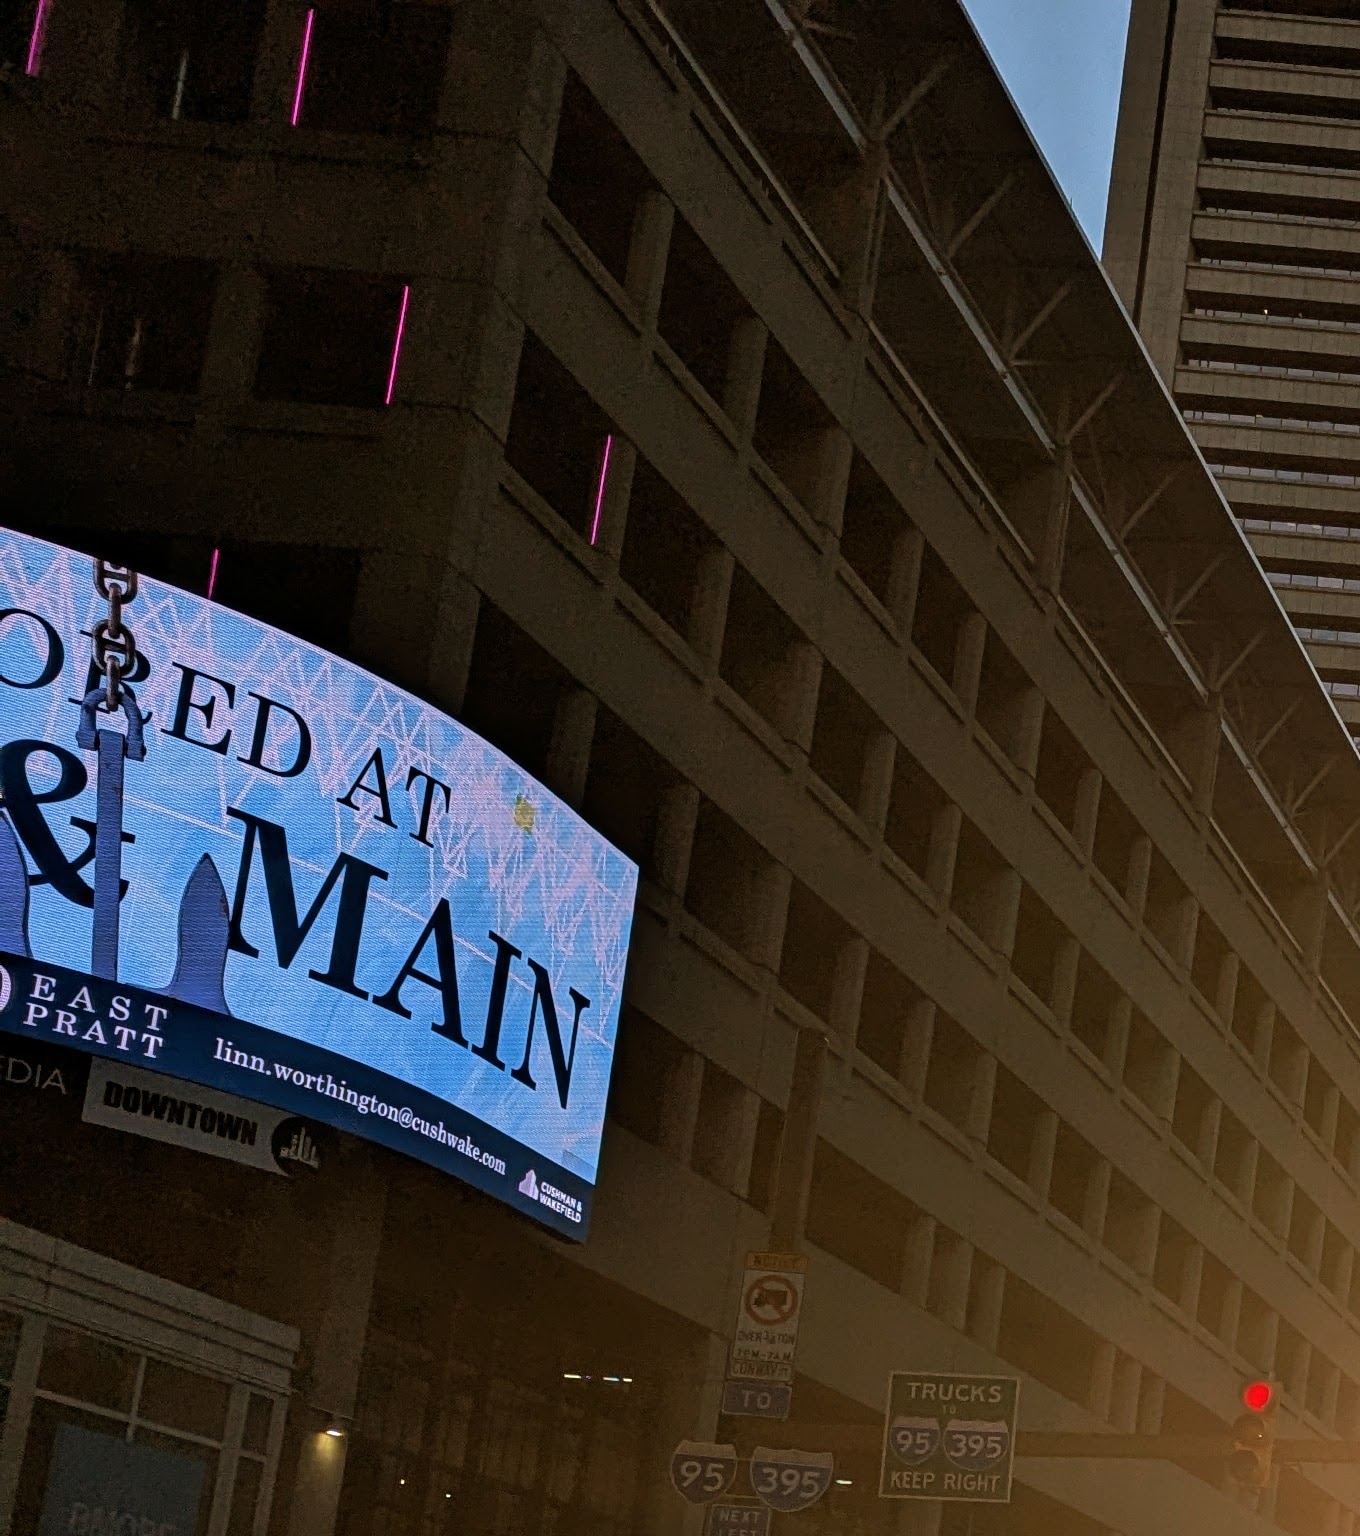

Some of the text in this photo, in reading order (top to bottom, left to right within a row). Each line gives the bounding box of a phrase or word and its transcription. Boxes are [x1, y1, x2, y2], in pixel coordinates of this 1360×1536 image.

[337, 746, 452, 849] AT
[0, 738, 592, 1110] & MAIN
[29, 972, 168, 1032] EAST
[22, 1002, 164, 1059] PRATT
[0, 1055, 68, 1096] DIA
[103, 1080, 259, 1147] DOWNTOWN
[213, 1036, 507, 1177] linn.worthington@cushwake.com
[539, 1192, 582, 1223] WAKEFIELD
[540, 1181, 582, 1213] CUSHMAN &
[741, 1389, 772, 1411] TO
[906, 1381, 1002, 1404] TRUCKS
[942, 1404, 958, 1416] TO
[895, 1429, 1003, 1460] 95 395
[679, 1460, 822, 1499] 95 395
[890, 1470, 1002, 1493] KEEP RIGHT
[719, 1509, 763, 1525] NEXT
